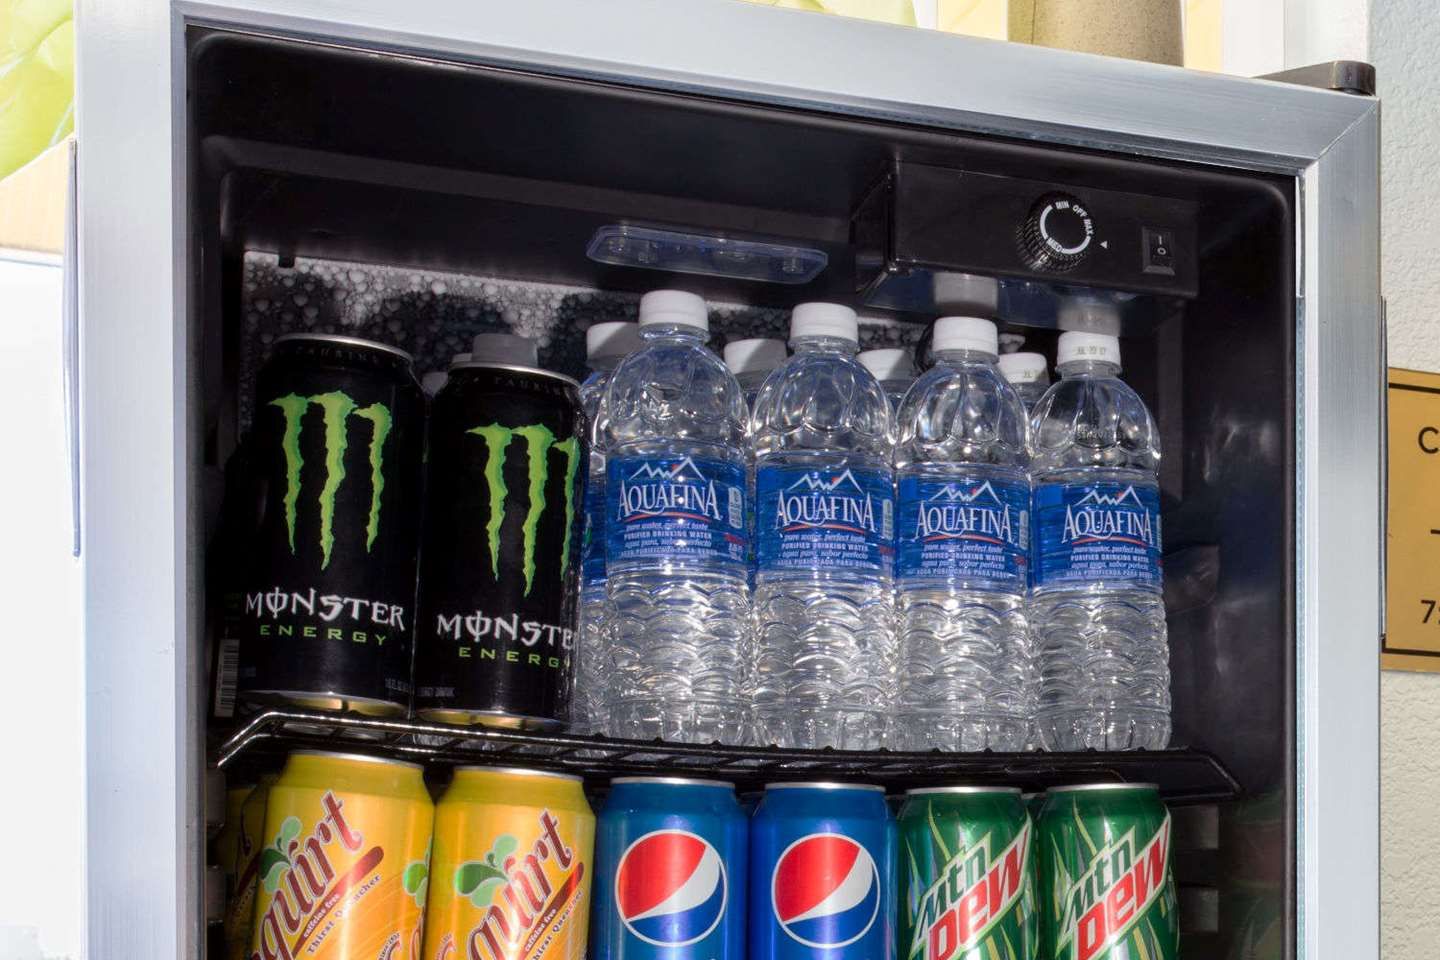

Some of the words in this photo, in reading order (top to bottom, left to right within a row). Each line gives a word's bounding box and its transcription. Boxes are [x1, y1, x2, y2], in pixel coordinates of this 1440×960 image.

[616, 480, 723, 521] AQUAFINA
[775, 489, 878, 533] AQUAFINA
[914, 500, 1014, 544] AQUAFINA
[1061, 504, 1153, 544] AQUAFINA
[246, 586, 405, 631] MONSTER
[260, 624, 387, 646] ENERGY
[436, 610, 574, 650] MONSTE
